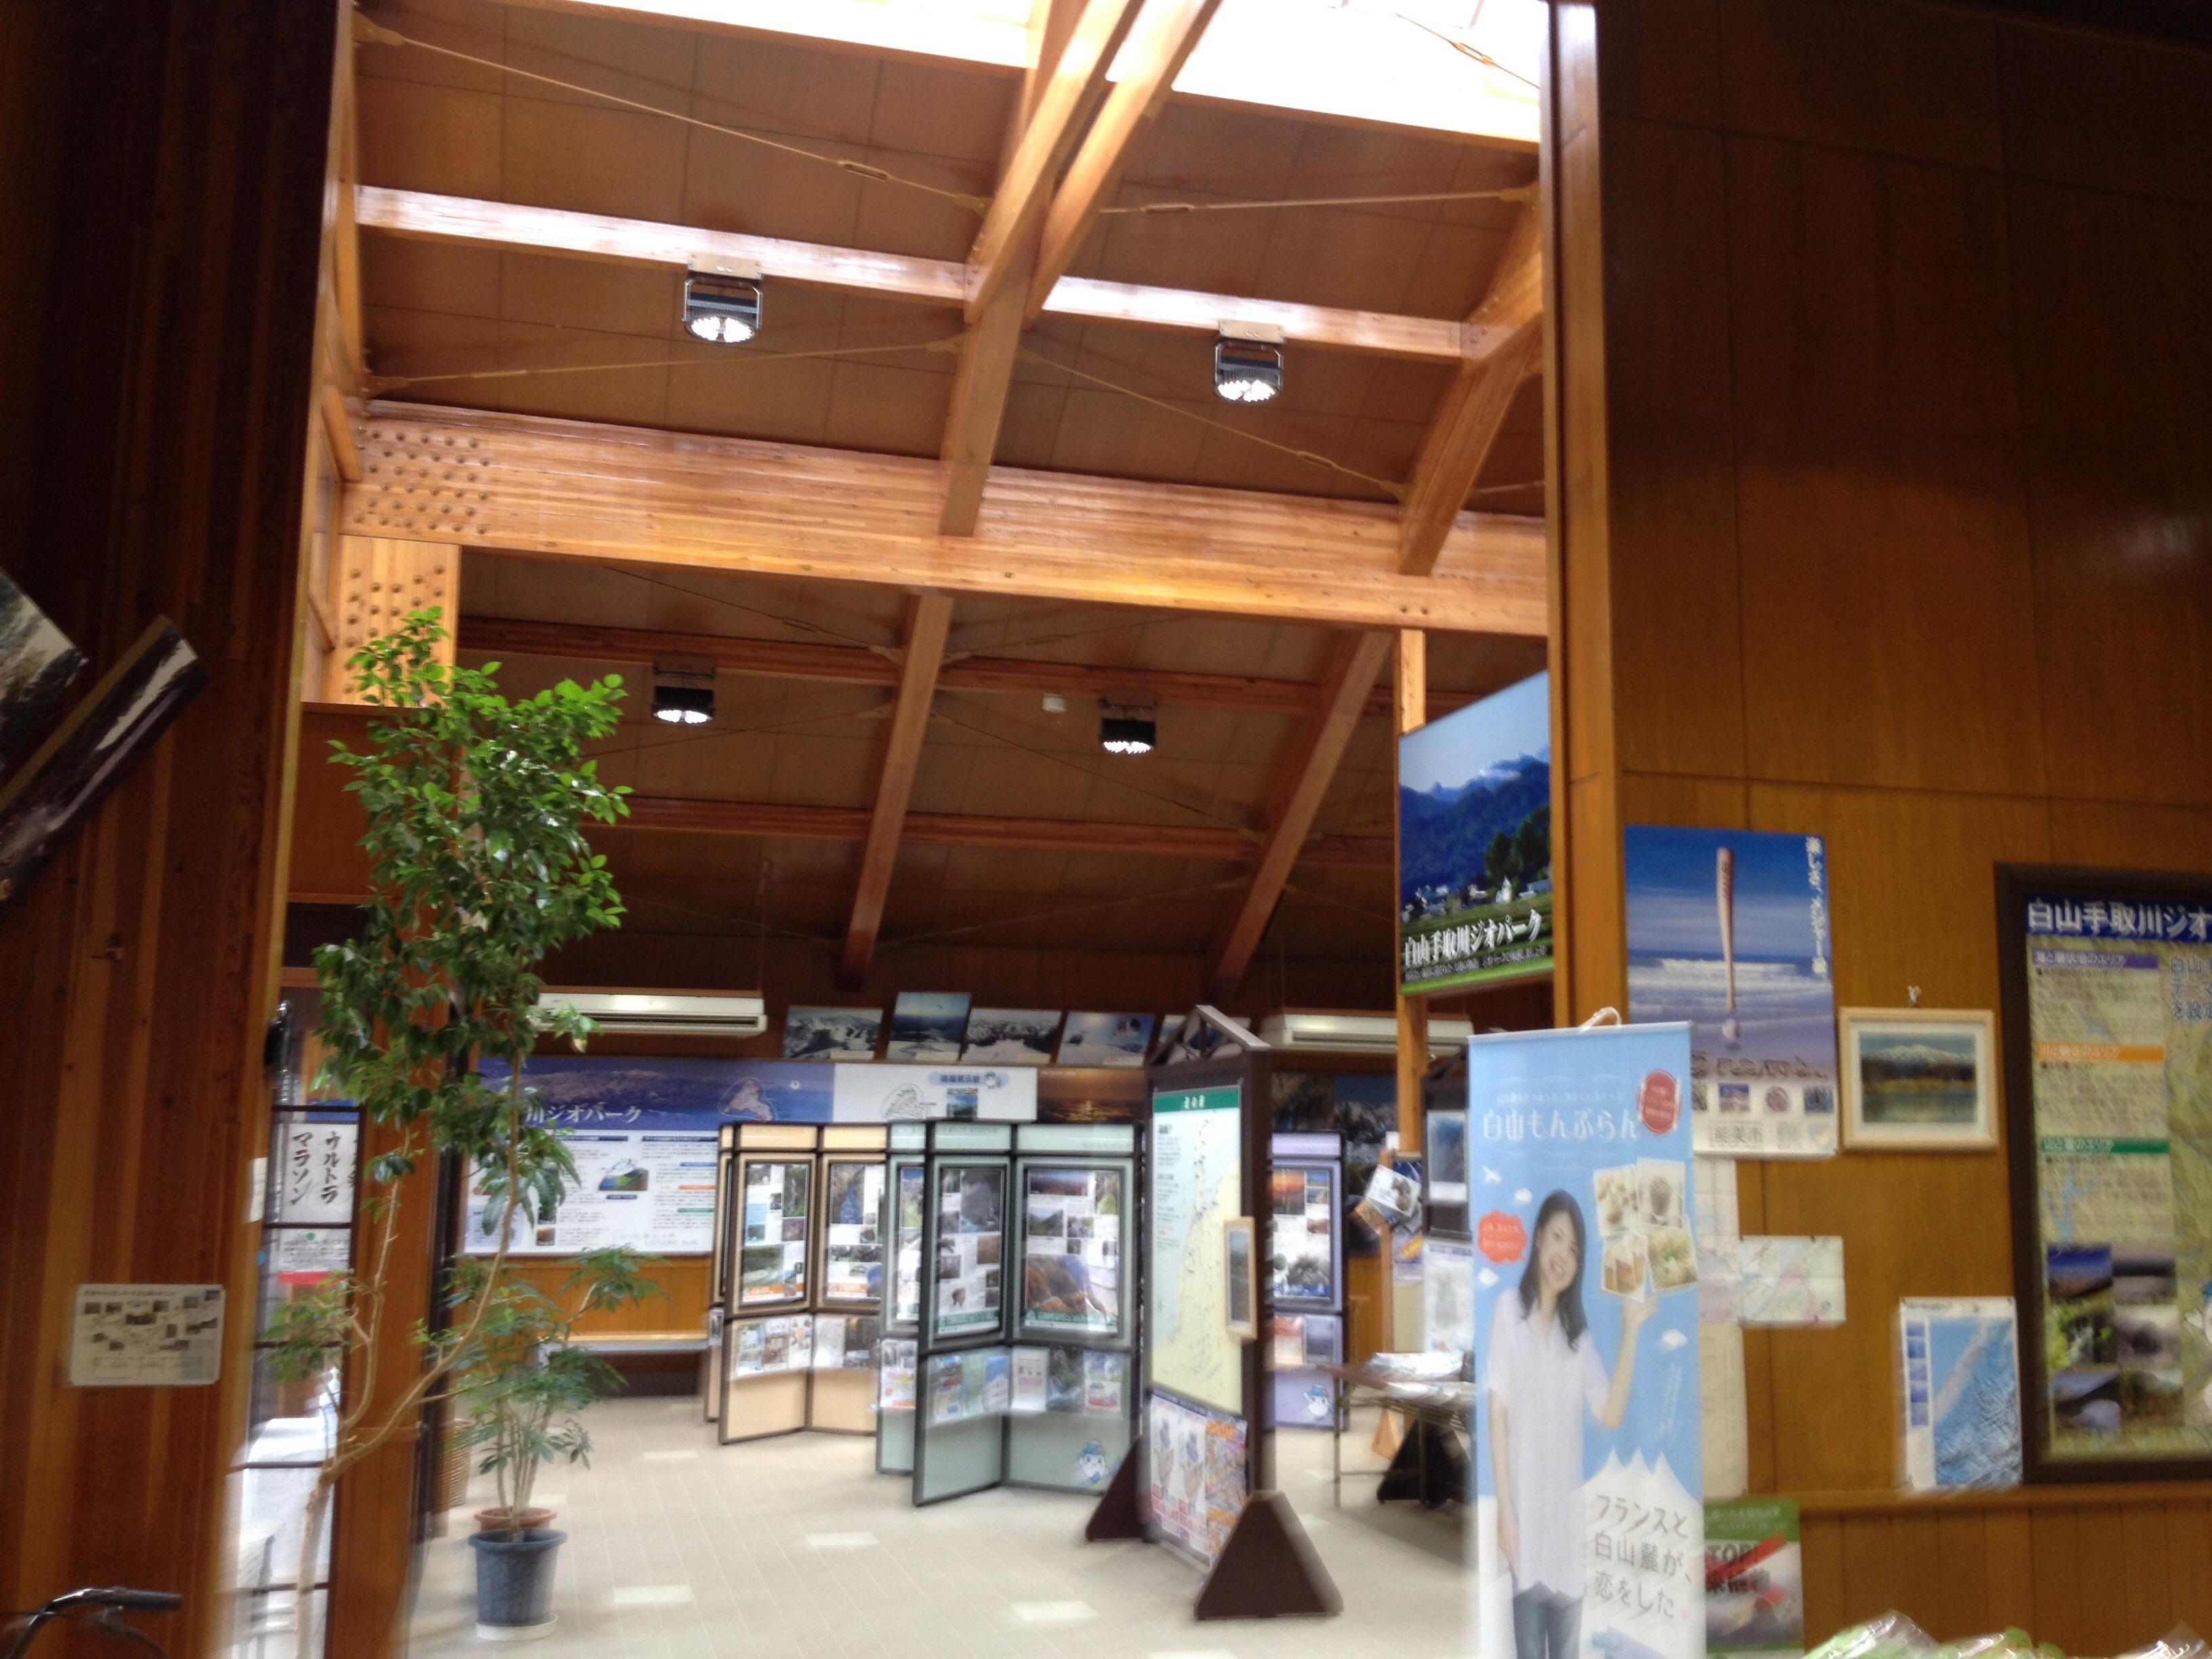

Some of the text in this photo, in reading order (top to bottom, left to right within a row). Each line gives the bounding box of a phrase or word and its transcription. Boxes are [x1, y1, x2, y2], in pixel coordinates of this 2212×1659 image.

[1404, 909, 1542, 968] 白山手取川ジオパーク
[2027, 898, 2212, 941] 白山手取川ジオ
[1483, 1108, 1639, 1141] 白山もんぶらん
[291, 1131, 312, 1206] マラソン
[321, 1130, 341, 1204] ウルトラ
[1596, 1494, 1689, 1538] フランスと
[1594, 1570, 1675, 1619] 恋をした
